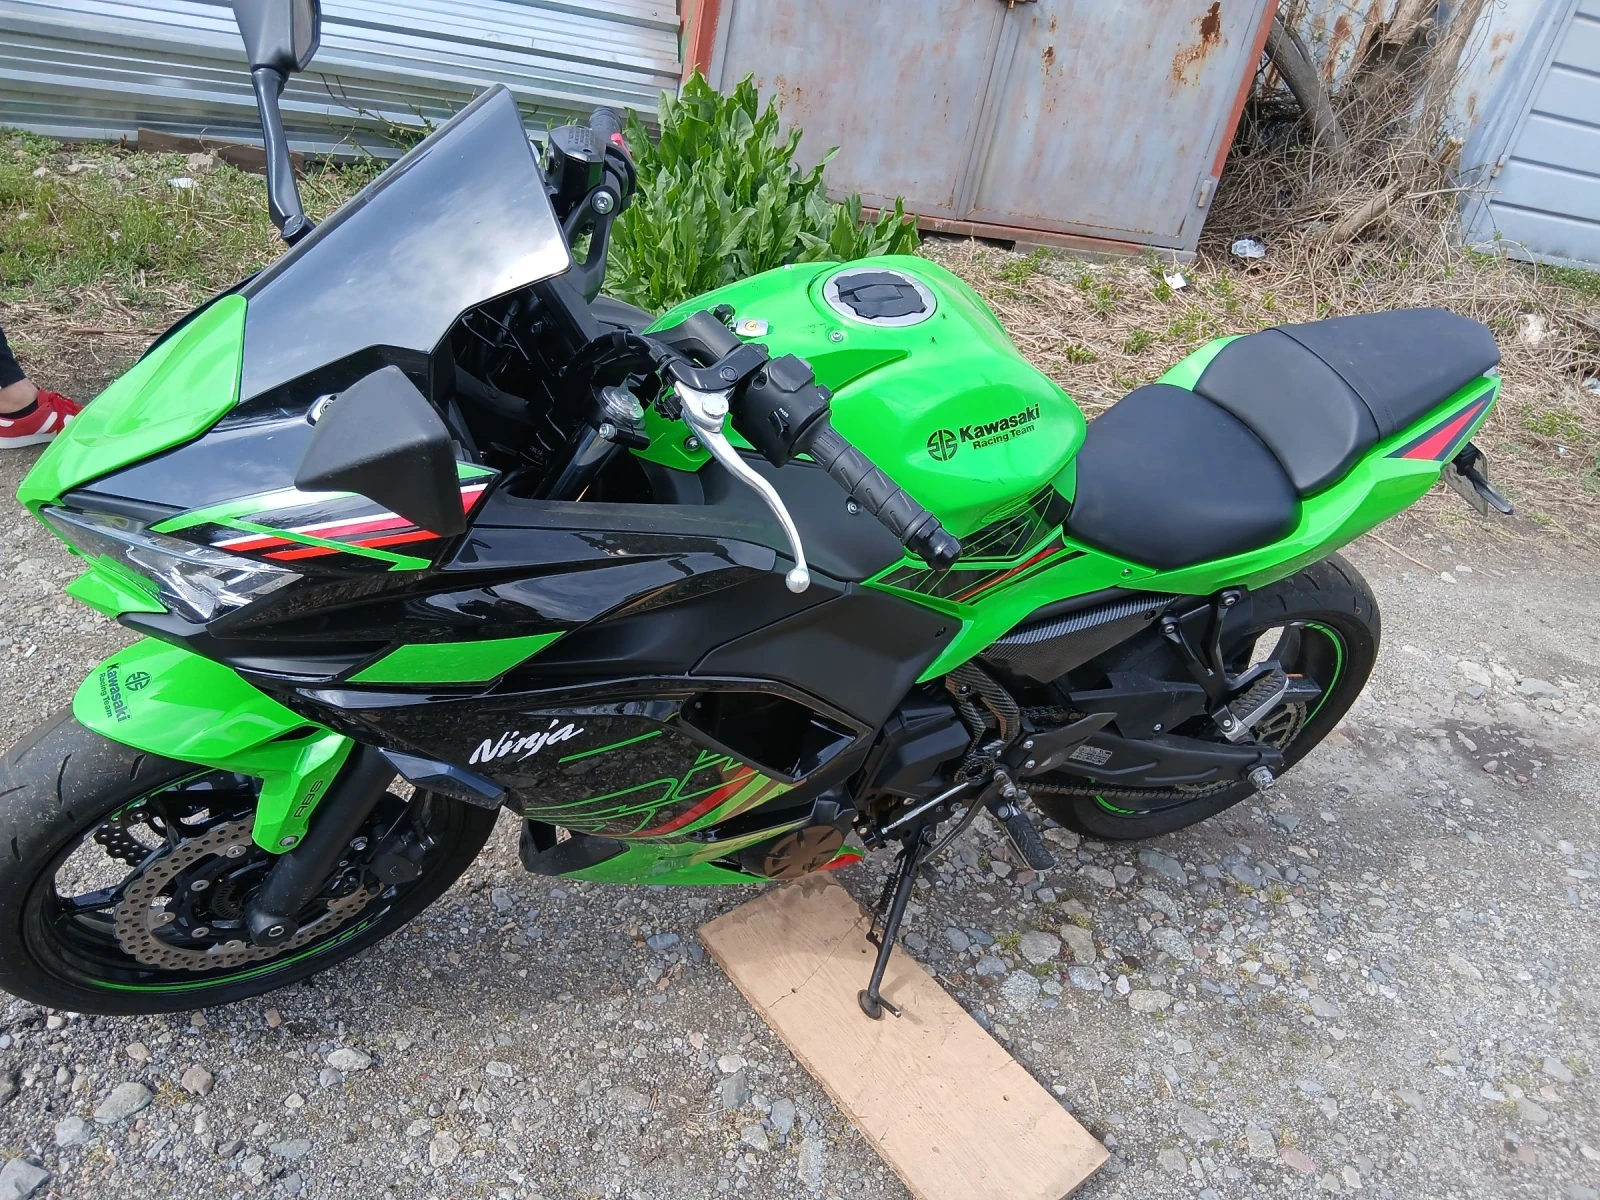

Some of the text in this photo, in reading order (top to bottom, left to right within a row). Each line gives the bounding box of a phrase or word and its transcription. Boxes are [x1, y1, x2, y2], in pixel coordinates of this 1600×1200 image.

[959, 404, 1040, 442] Kawasaki
[973, 424, 1035, 450] Racing Team
[99, 672, 113, 718] Racing Team
[107, 662, 131, 722] Kawasaki
[469, 719, 585, 765] Ninja
[293, 780, 324, 818] ABS
